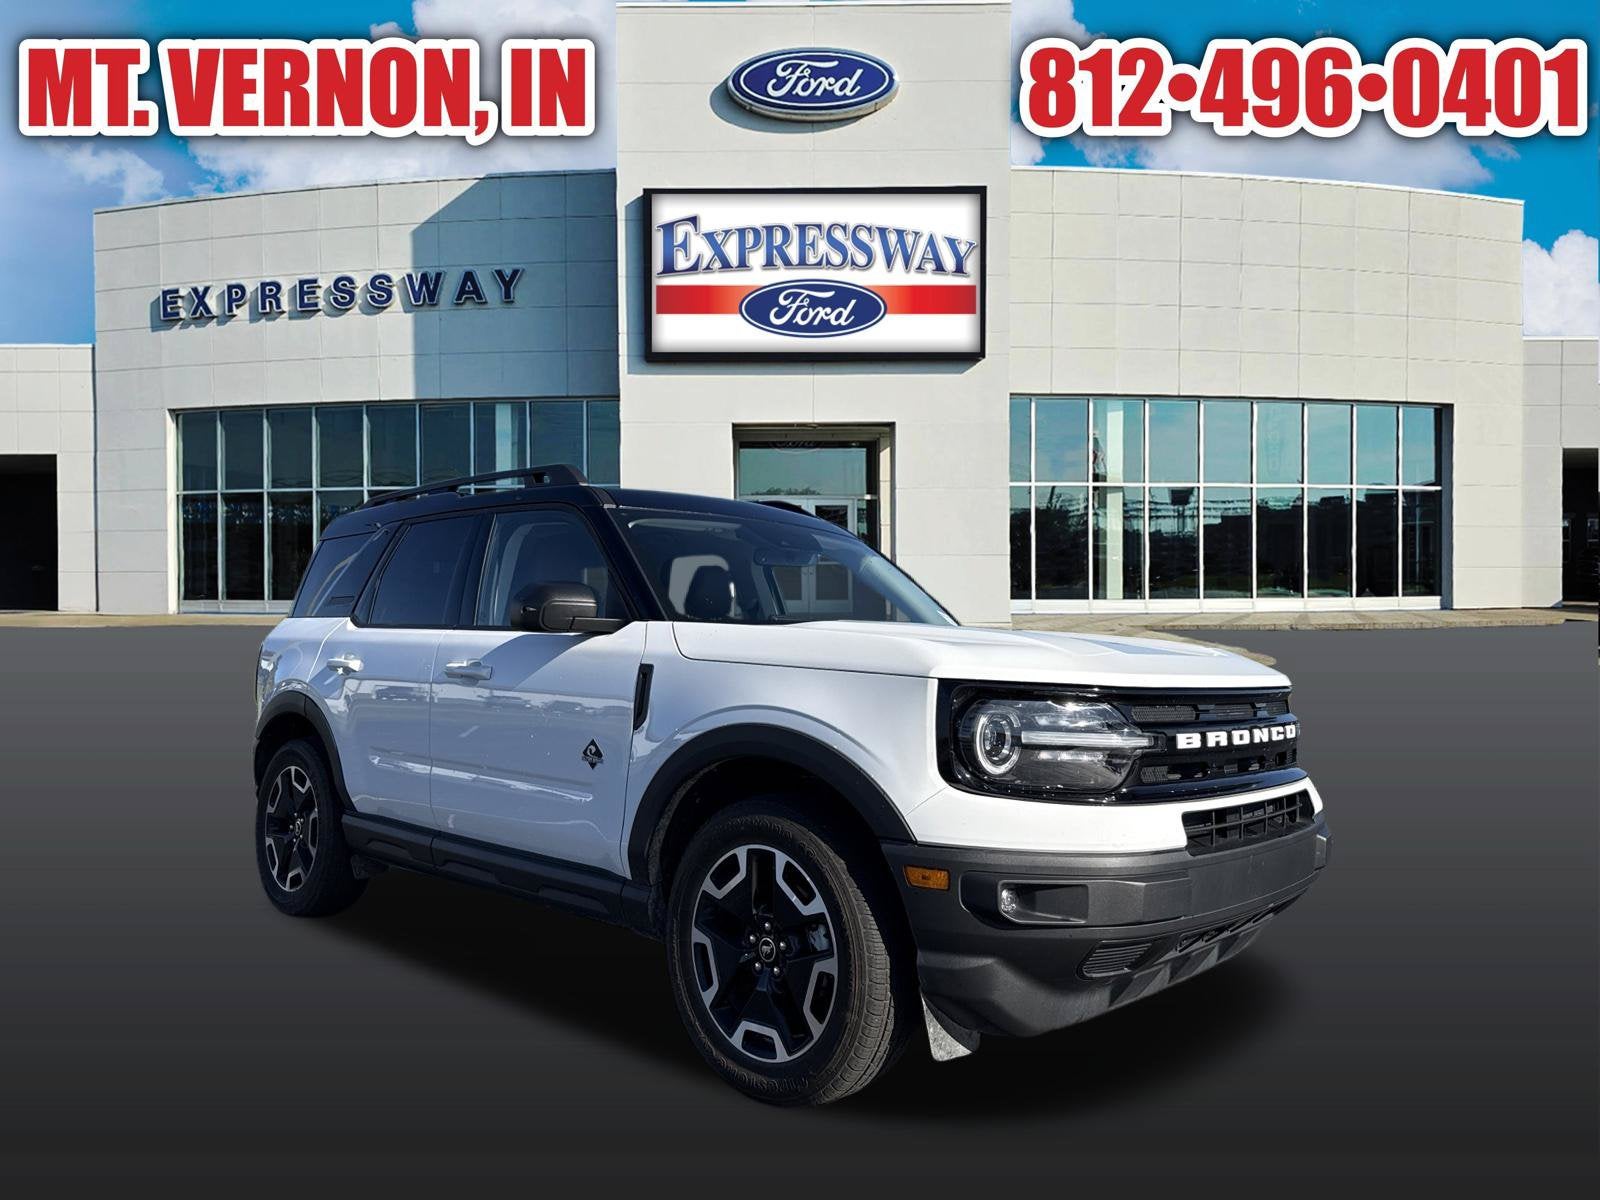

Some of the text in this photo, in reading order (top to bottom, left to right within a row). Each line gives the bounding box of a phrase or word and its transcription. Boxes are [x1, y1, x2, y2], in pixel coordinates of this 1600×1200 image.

[767, 60, 863, 97] Ford
[656, 214, 977, 277] EXPRESSWAY
[160, 268, 524, 320] EXPRESSWAY
[769, 288, 857, 327] Ford
[1176, 724, 1296, 749] BRONCO
